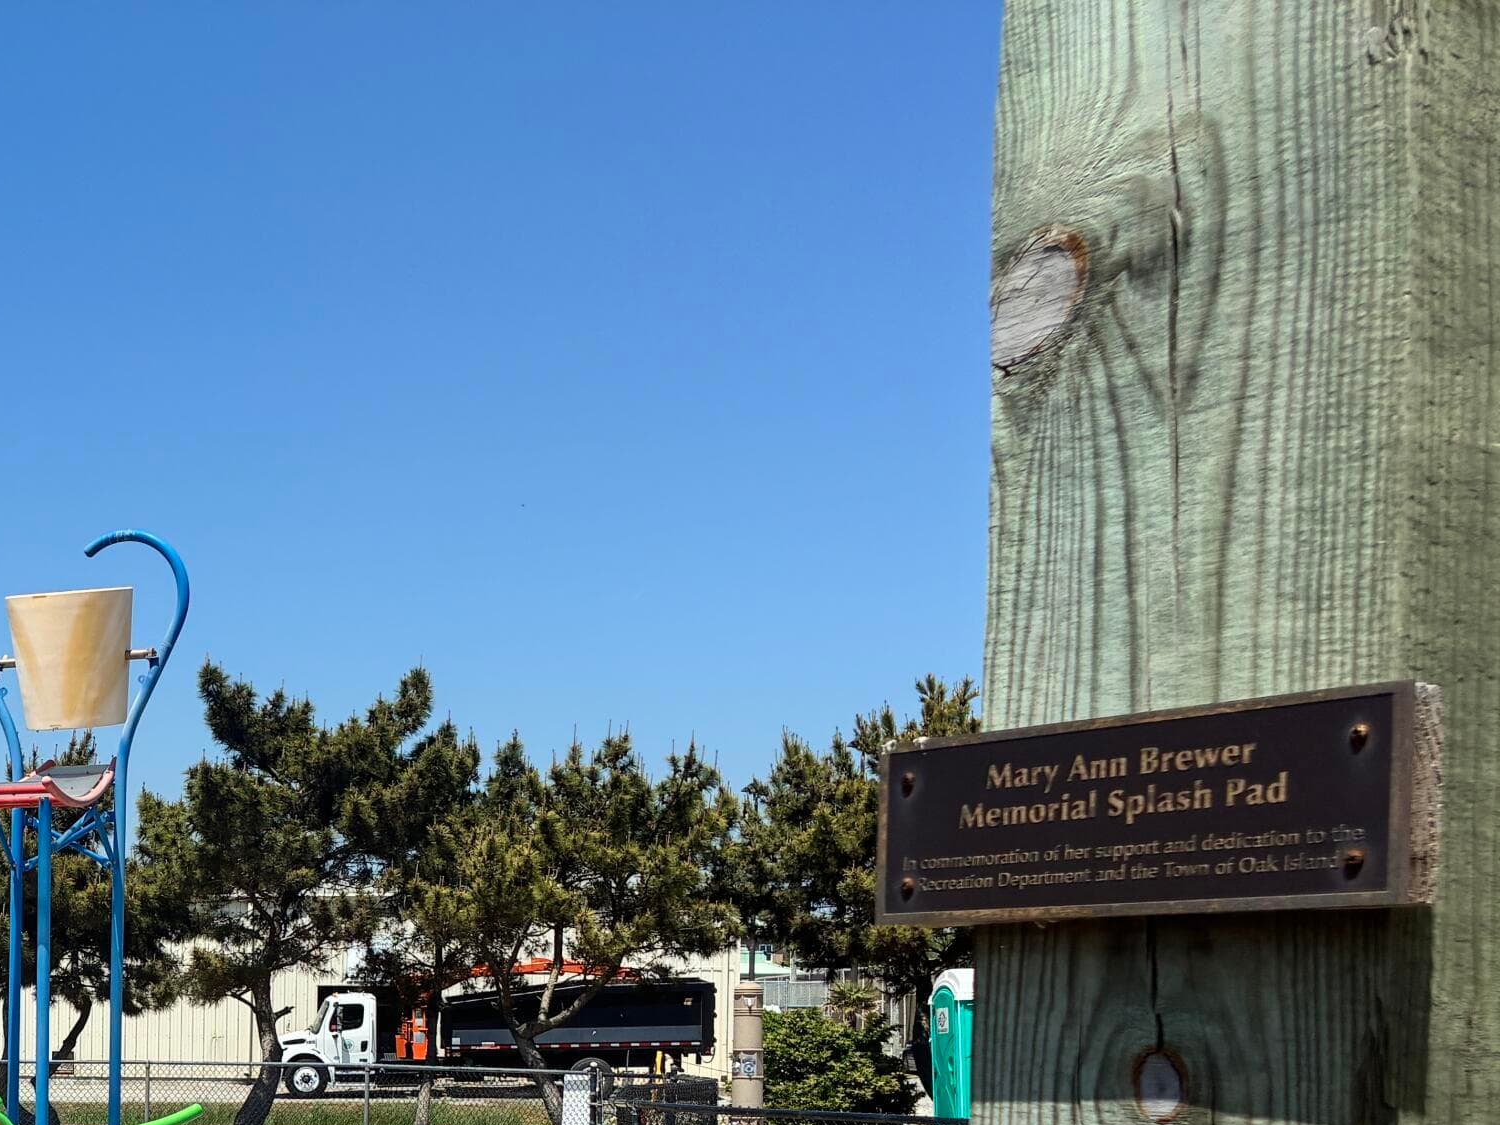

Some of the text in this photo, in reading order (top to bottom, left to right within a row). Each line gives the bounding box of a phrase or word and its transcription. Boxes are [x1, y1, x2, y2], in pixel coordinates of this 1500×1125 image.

[986, 742, 1257, 794] Mary Ann Brewer
[958, 771, 1290, 830] Memorial Splash Pad
[902, 824, 1366, 871] In commemoration of her support and dedication to the
[918, 850, 1341, 893] Recreation Department and the Town of Oak Island
